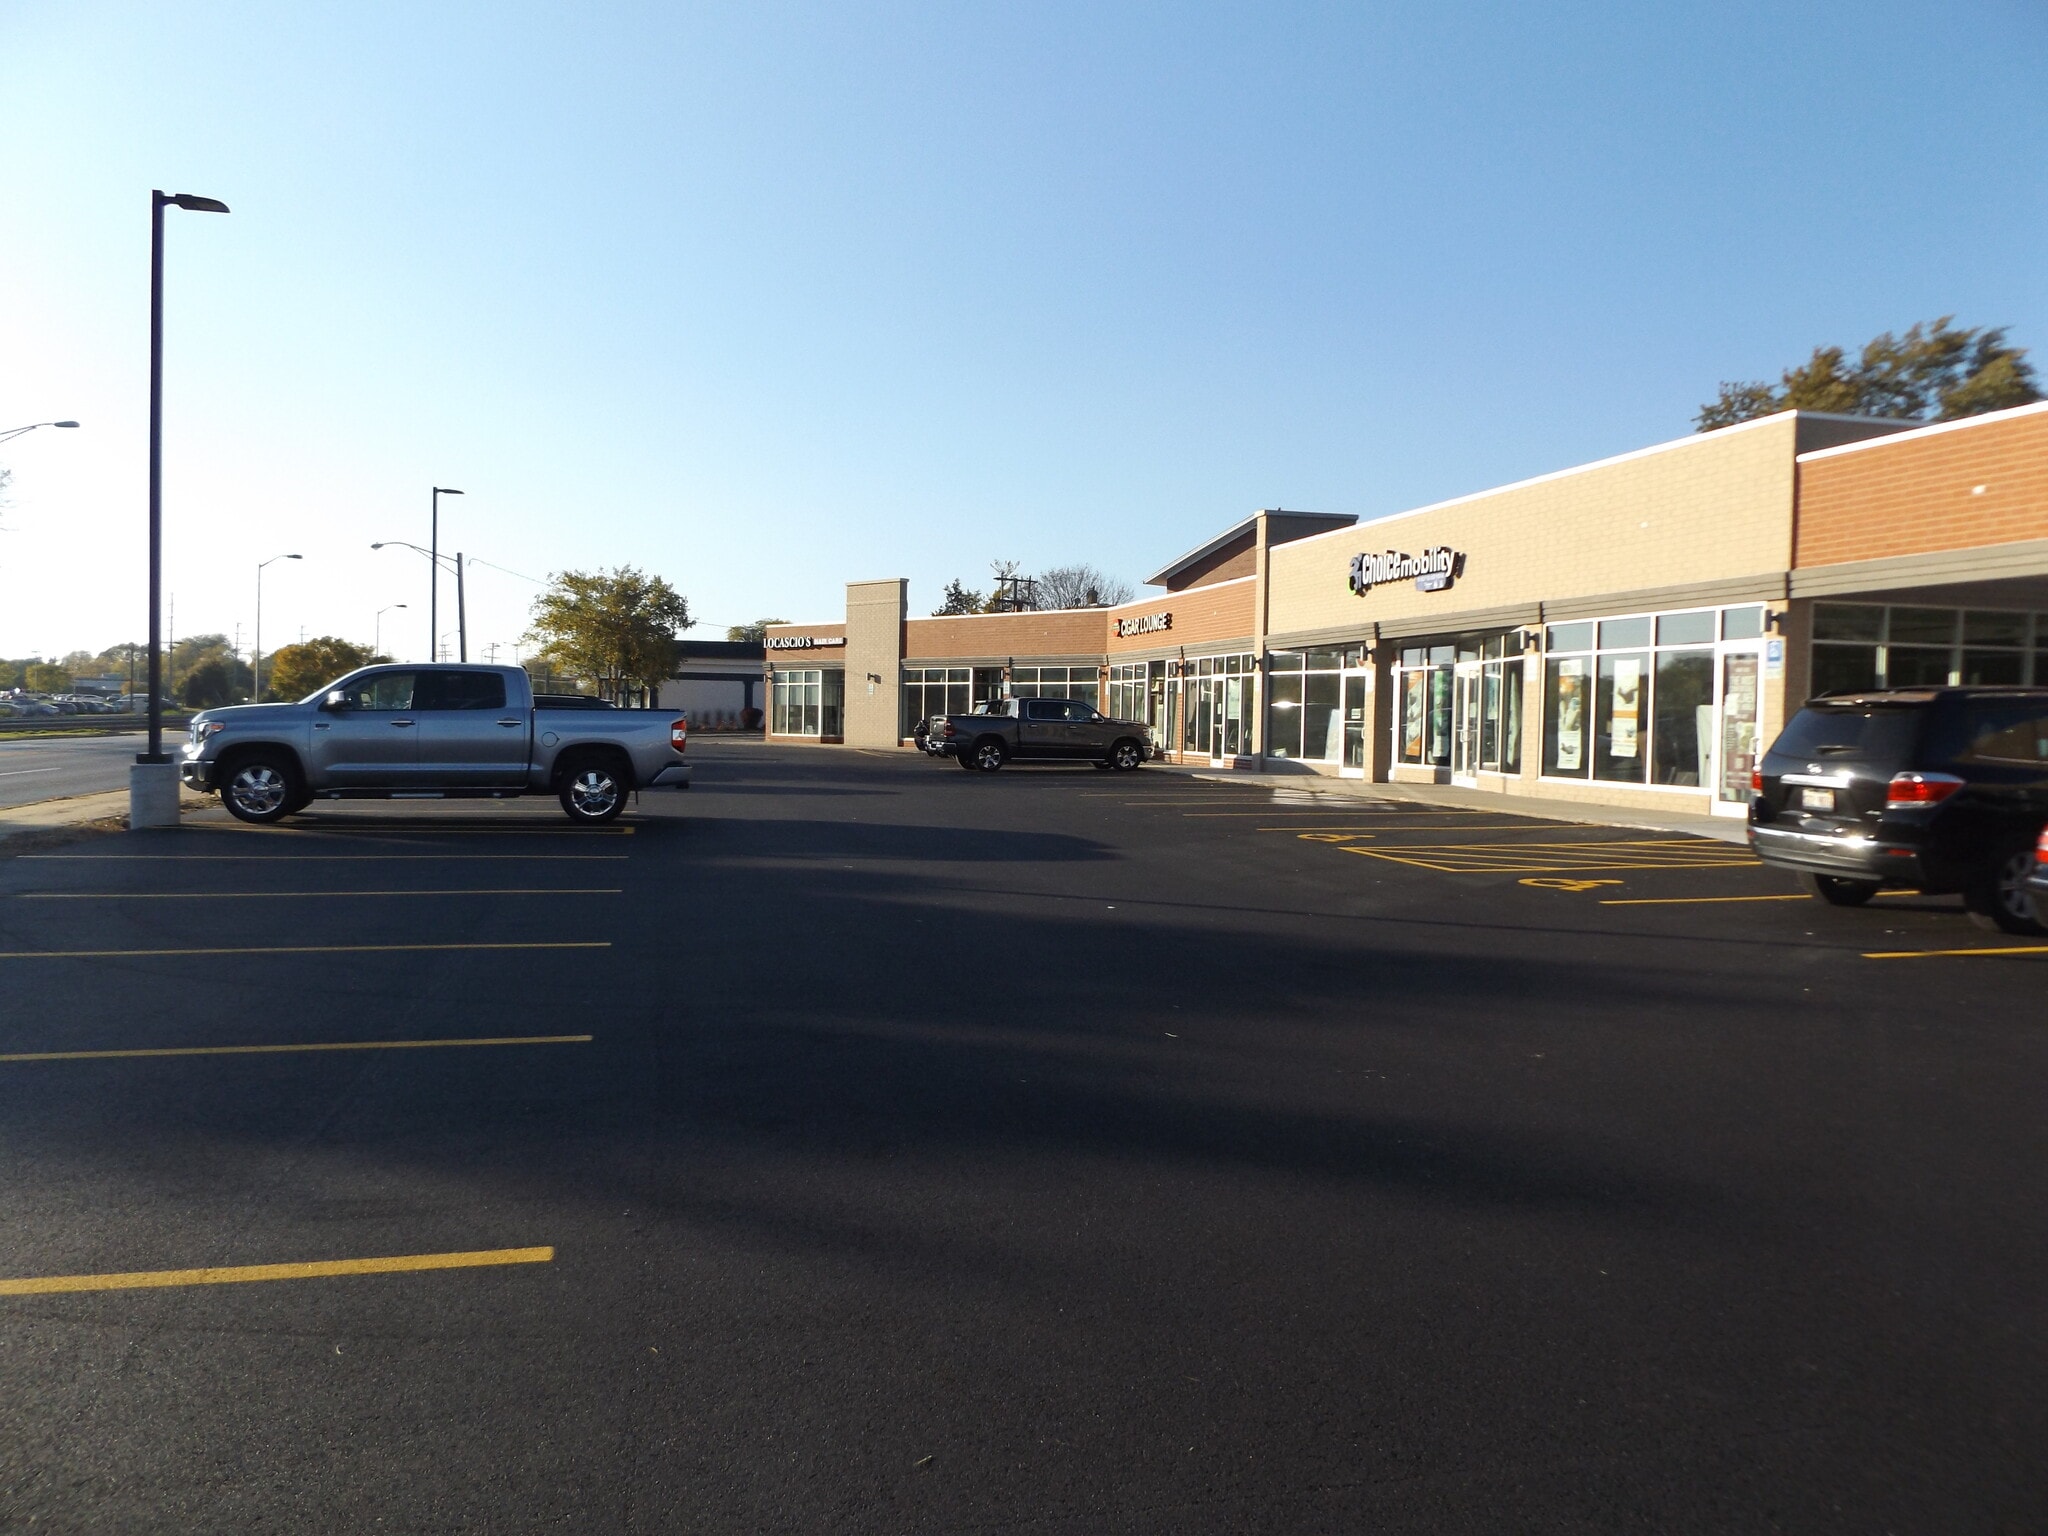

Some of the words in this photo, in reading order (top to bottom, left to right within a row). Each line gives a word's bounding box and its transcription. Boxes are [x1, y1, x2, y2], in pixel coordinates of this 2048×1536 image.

[1121, 619, 1139, 636] CIGAR
[1140, 612, 1167, 632] LOUNGE
[763, 636, 811, 648] LOCASCIO'S
